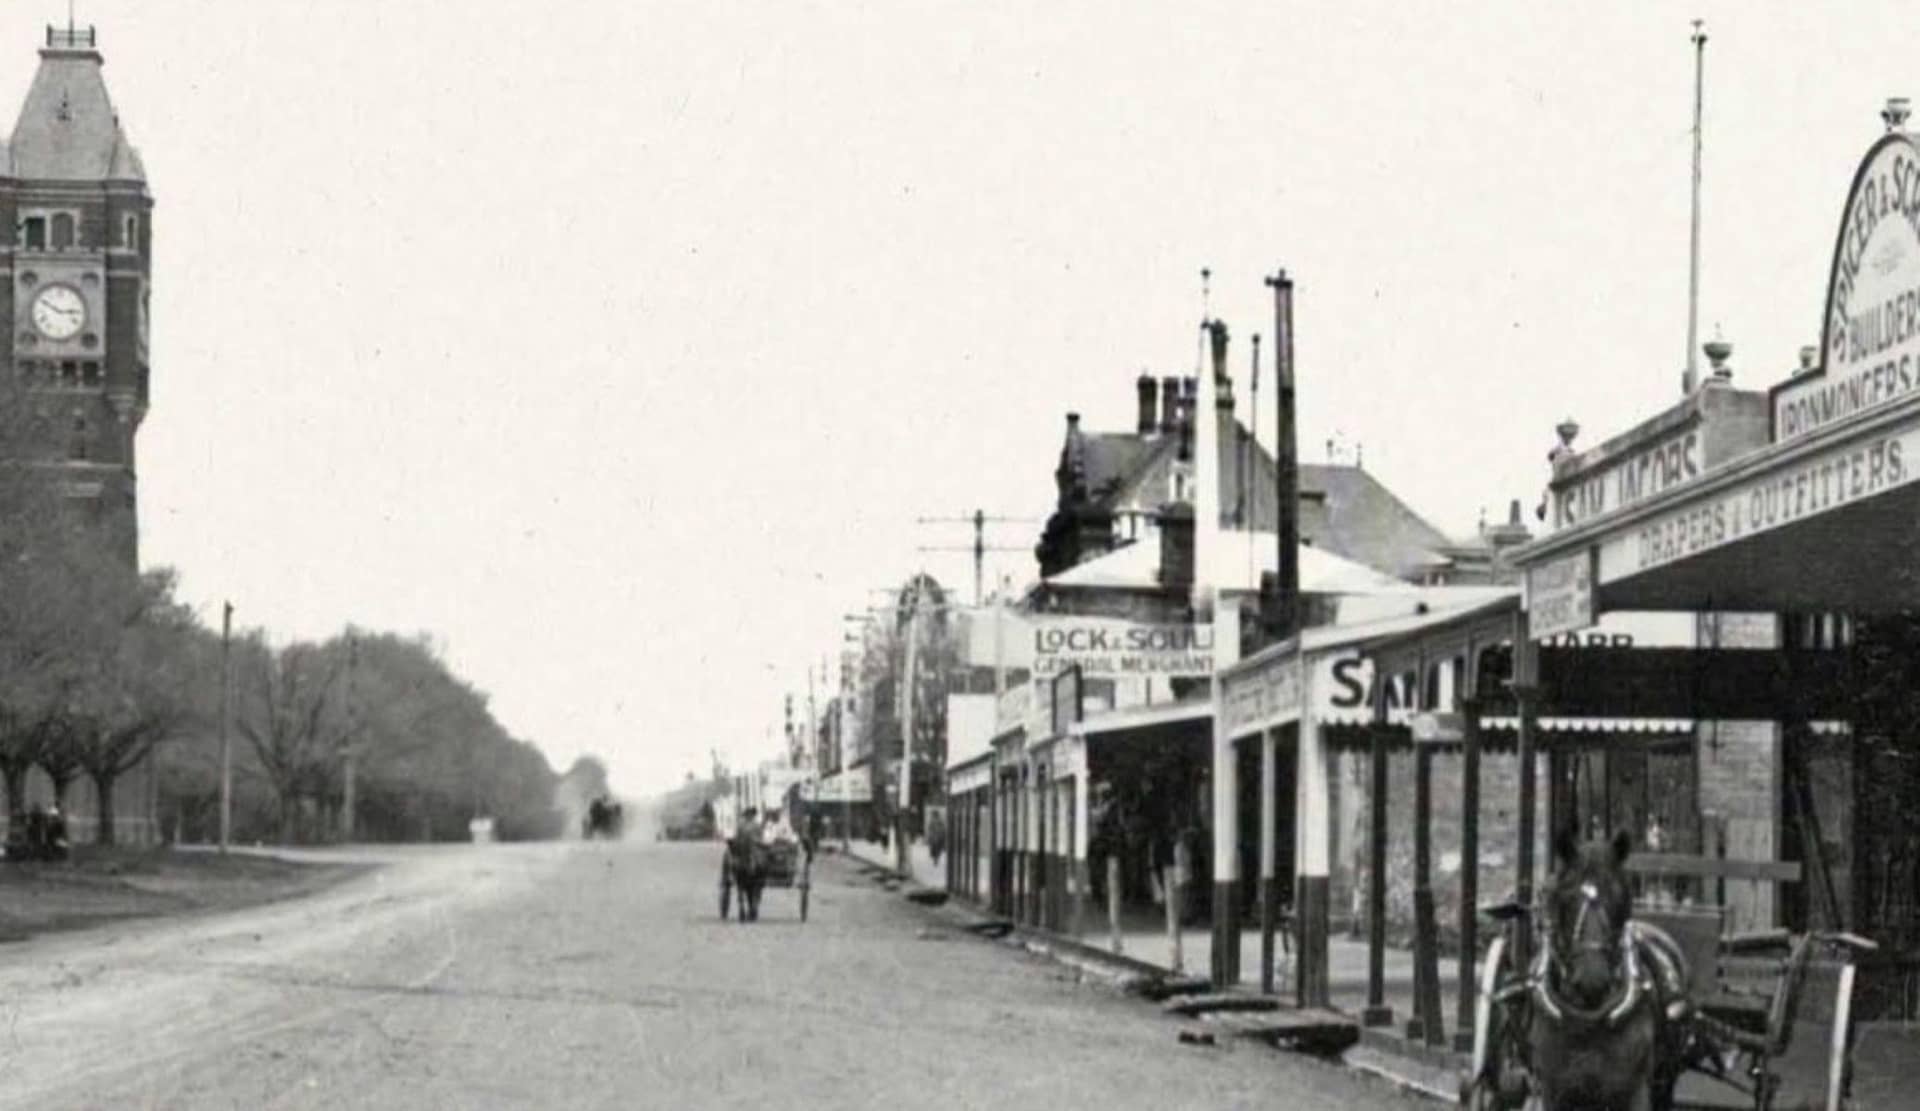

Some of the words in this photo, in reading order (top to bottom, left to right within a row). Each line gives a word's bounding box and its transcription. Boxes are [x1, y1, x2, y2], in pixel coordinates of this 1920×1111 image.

[1833, 178, 1877, 362] SPICER
[1640, 502, 1725, 567] DRAPERS
[1035, 629, 1108, 654] LOCK
